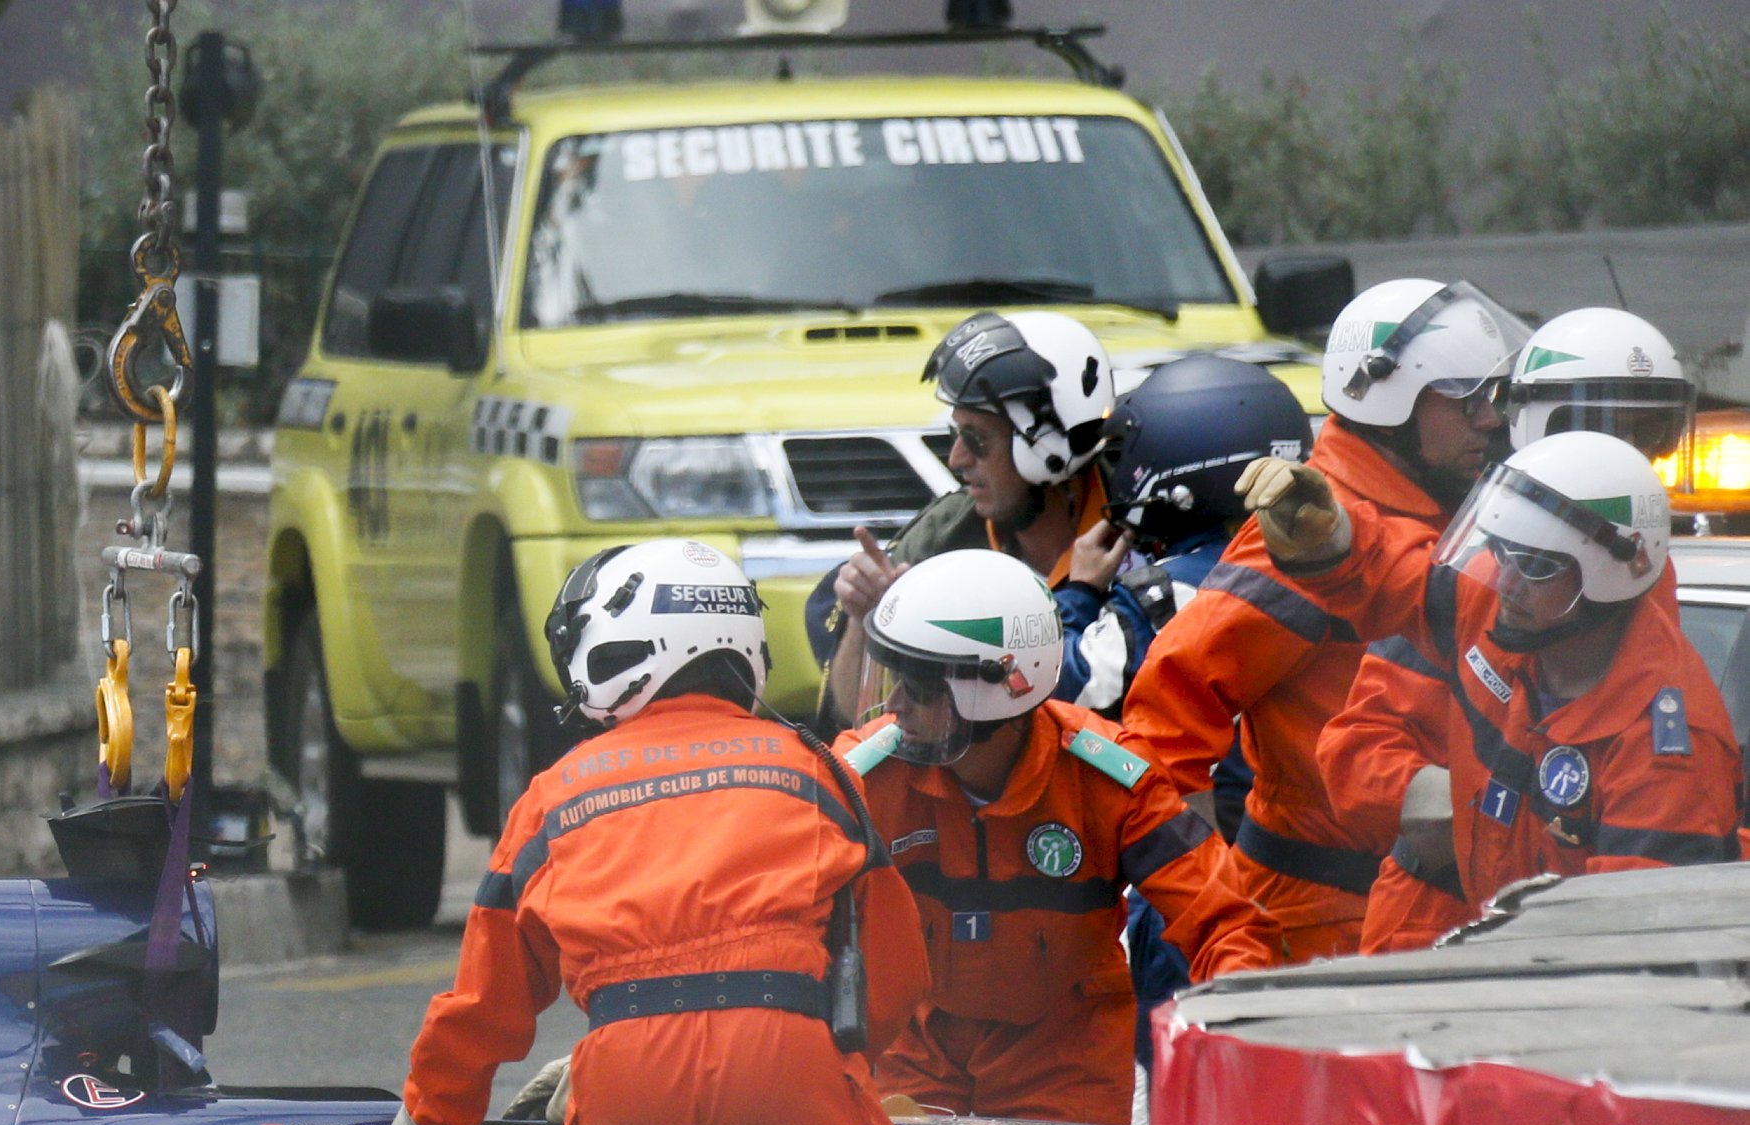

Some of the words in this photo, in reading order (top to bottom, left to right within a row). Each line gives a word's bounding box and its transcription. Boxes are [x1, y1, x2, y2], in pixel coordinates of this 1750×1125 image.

[620, 120, 866, 182] SECURITE
[882, 116, 1085, 165] CIRCUIT
[945, 320, 998, 371] CM
[670, 585, 748, 604] SECTEUR
[691, 603, 749, 614] ALPHA
[1007, 612, 1059, 650] ACM
[561, 747, 635, 786] CHEF
[642, 743, 679, 766] DE
[689, 735, 784, 758] POSTE
[559, 782, 655, 829] AUTOMOBILE
[660, 774, 702, 795] CLUB
[707, 768, 729, 787] DE
[733, 767, 801, 792] MONACO
[1495, 789, 1508, 819] 1
[966, 915, 978, 940] 1
